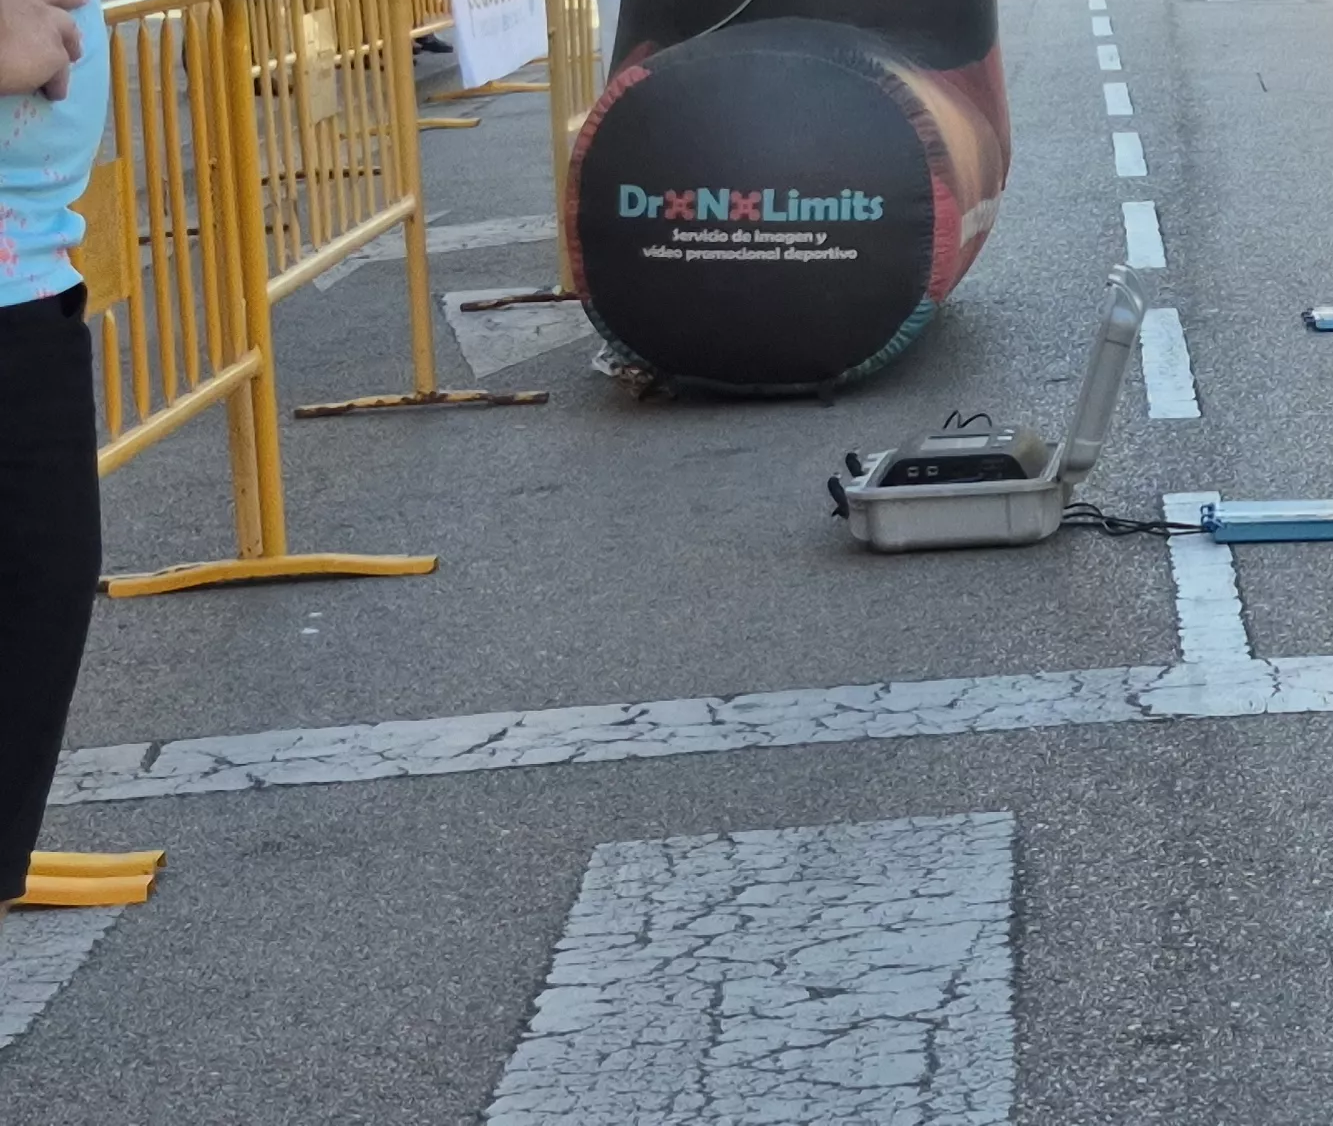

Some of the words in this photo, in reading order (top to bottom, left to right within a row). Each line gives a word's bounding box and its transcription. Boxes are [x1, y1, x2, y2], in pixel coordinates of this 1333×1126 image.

[672, 228, 728, 243] Servicio
[731, 229, 751, 243] de
[815, 232, 827, 245] y
[686, 247, 780, 262] promocional
[784, 247, 858, 263] deportivo
